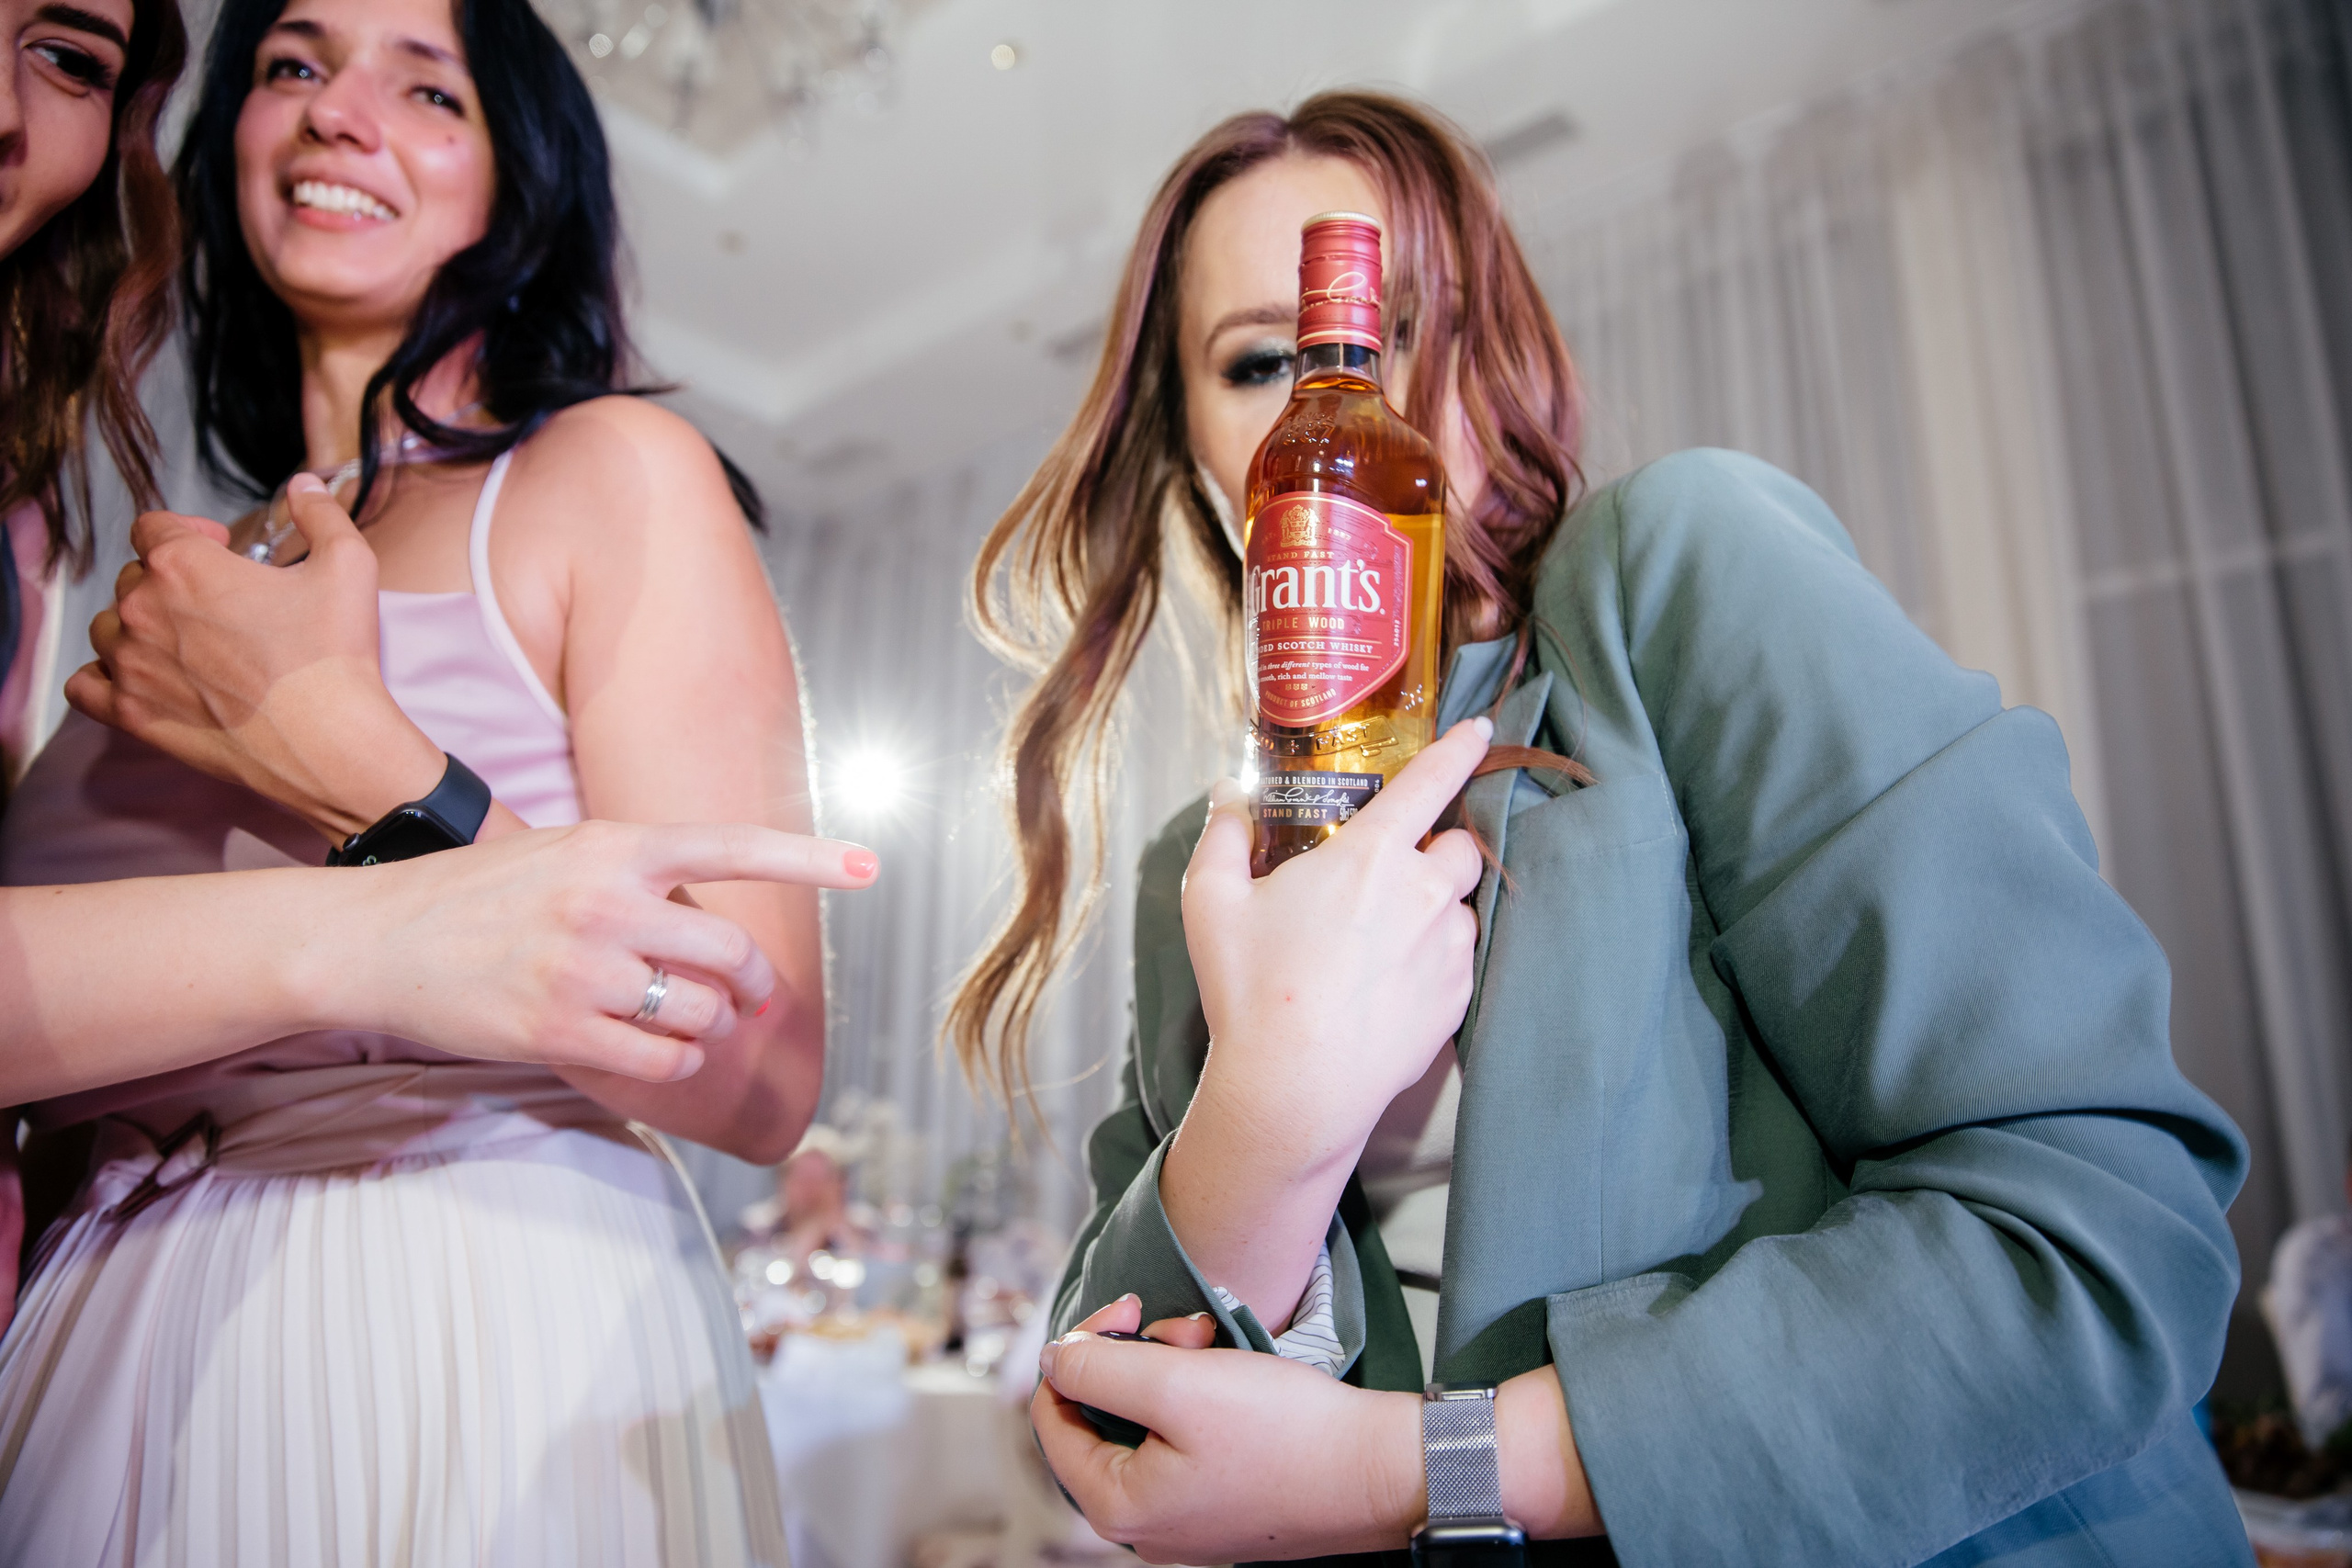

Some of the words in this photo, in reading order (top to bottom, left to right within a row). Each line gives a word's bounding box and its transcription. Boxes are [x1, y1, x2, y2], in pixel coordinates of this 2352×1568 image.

[1268, 552, 1298, 562] STAND
[1262, 617, 1298, 631] TRIPLE
[1308, 616, 1345, 630] WOOD
[1277, 641, 1325, 650] SCOTCH
[1329, 642, 1374, 653] WHISKY
[1281, 661, 1311, 670] different
[1312, 661, 1332, 670] types
[1360, 663, 1370, 671] for
[1338, 673, 1352, 682] taste
[1265, 690, 1286, 706] PRODUCT
[1289, 700, 1298, 708] OF
[1301, 688, 1337, 707] SCOTLAND
[1284, 776, 1290, 784] &
[1292, 776, 1326, 785] BLENDED
[1328, 777, 1335, 785] IN
[1338, 777, 1368, 787] SCOTLAND
[1263, 808, 1292, 818] STAND
[1298, 808, 1328, 818] FAST
